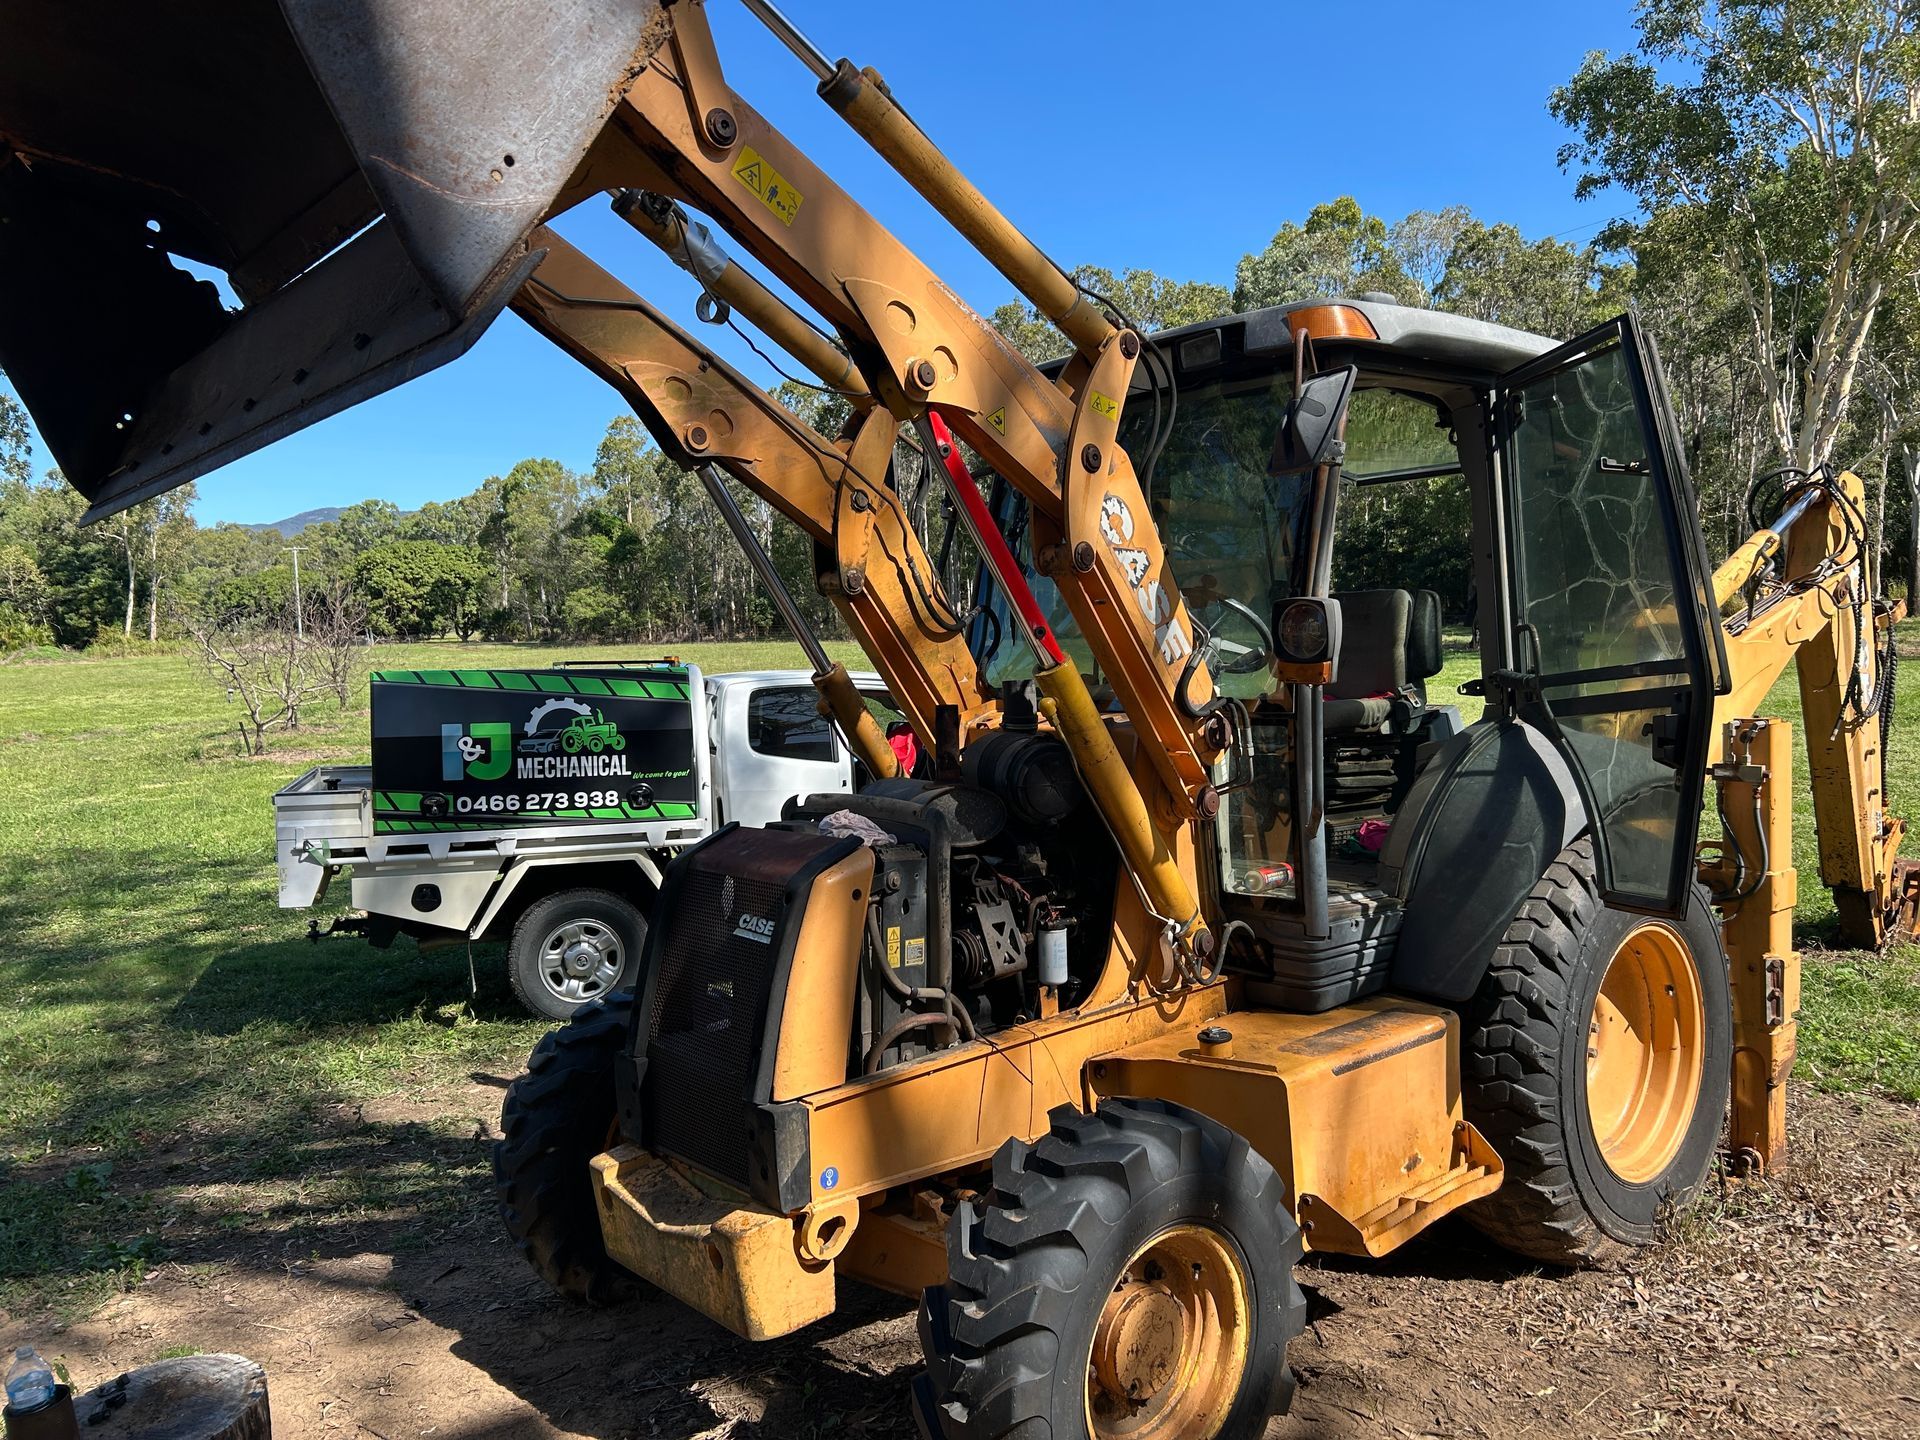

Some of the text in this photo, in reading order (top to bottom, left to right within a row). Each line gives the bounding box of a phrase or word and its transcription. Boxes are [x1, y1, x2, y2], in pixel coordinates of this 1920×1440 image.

[1100, 494, 1193, 666] CASE
[517, 754, 632, 779] MECHANICAL
[632, 771, 645, 779] We
[664, 770, 673, 778] to
[673, 769, 690, 778] you!
[456, 790, 619, 813] 0466 273 938
[739, 913, 776, 936] CASE
